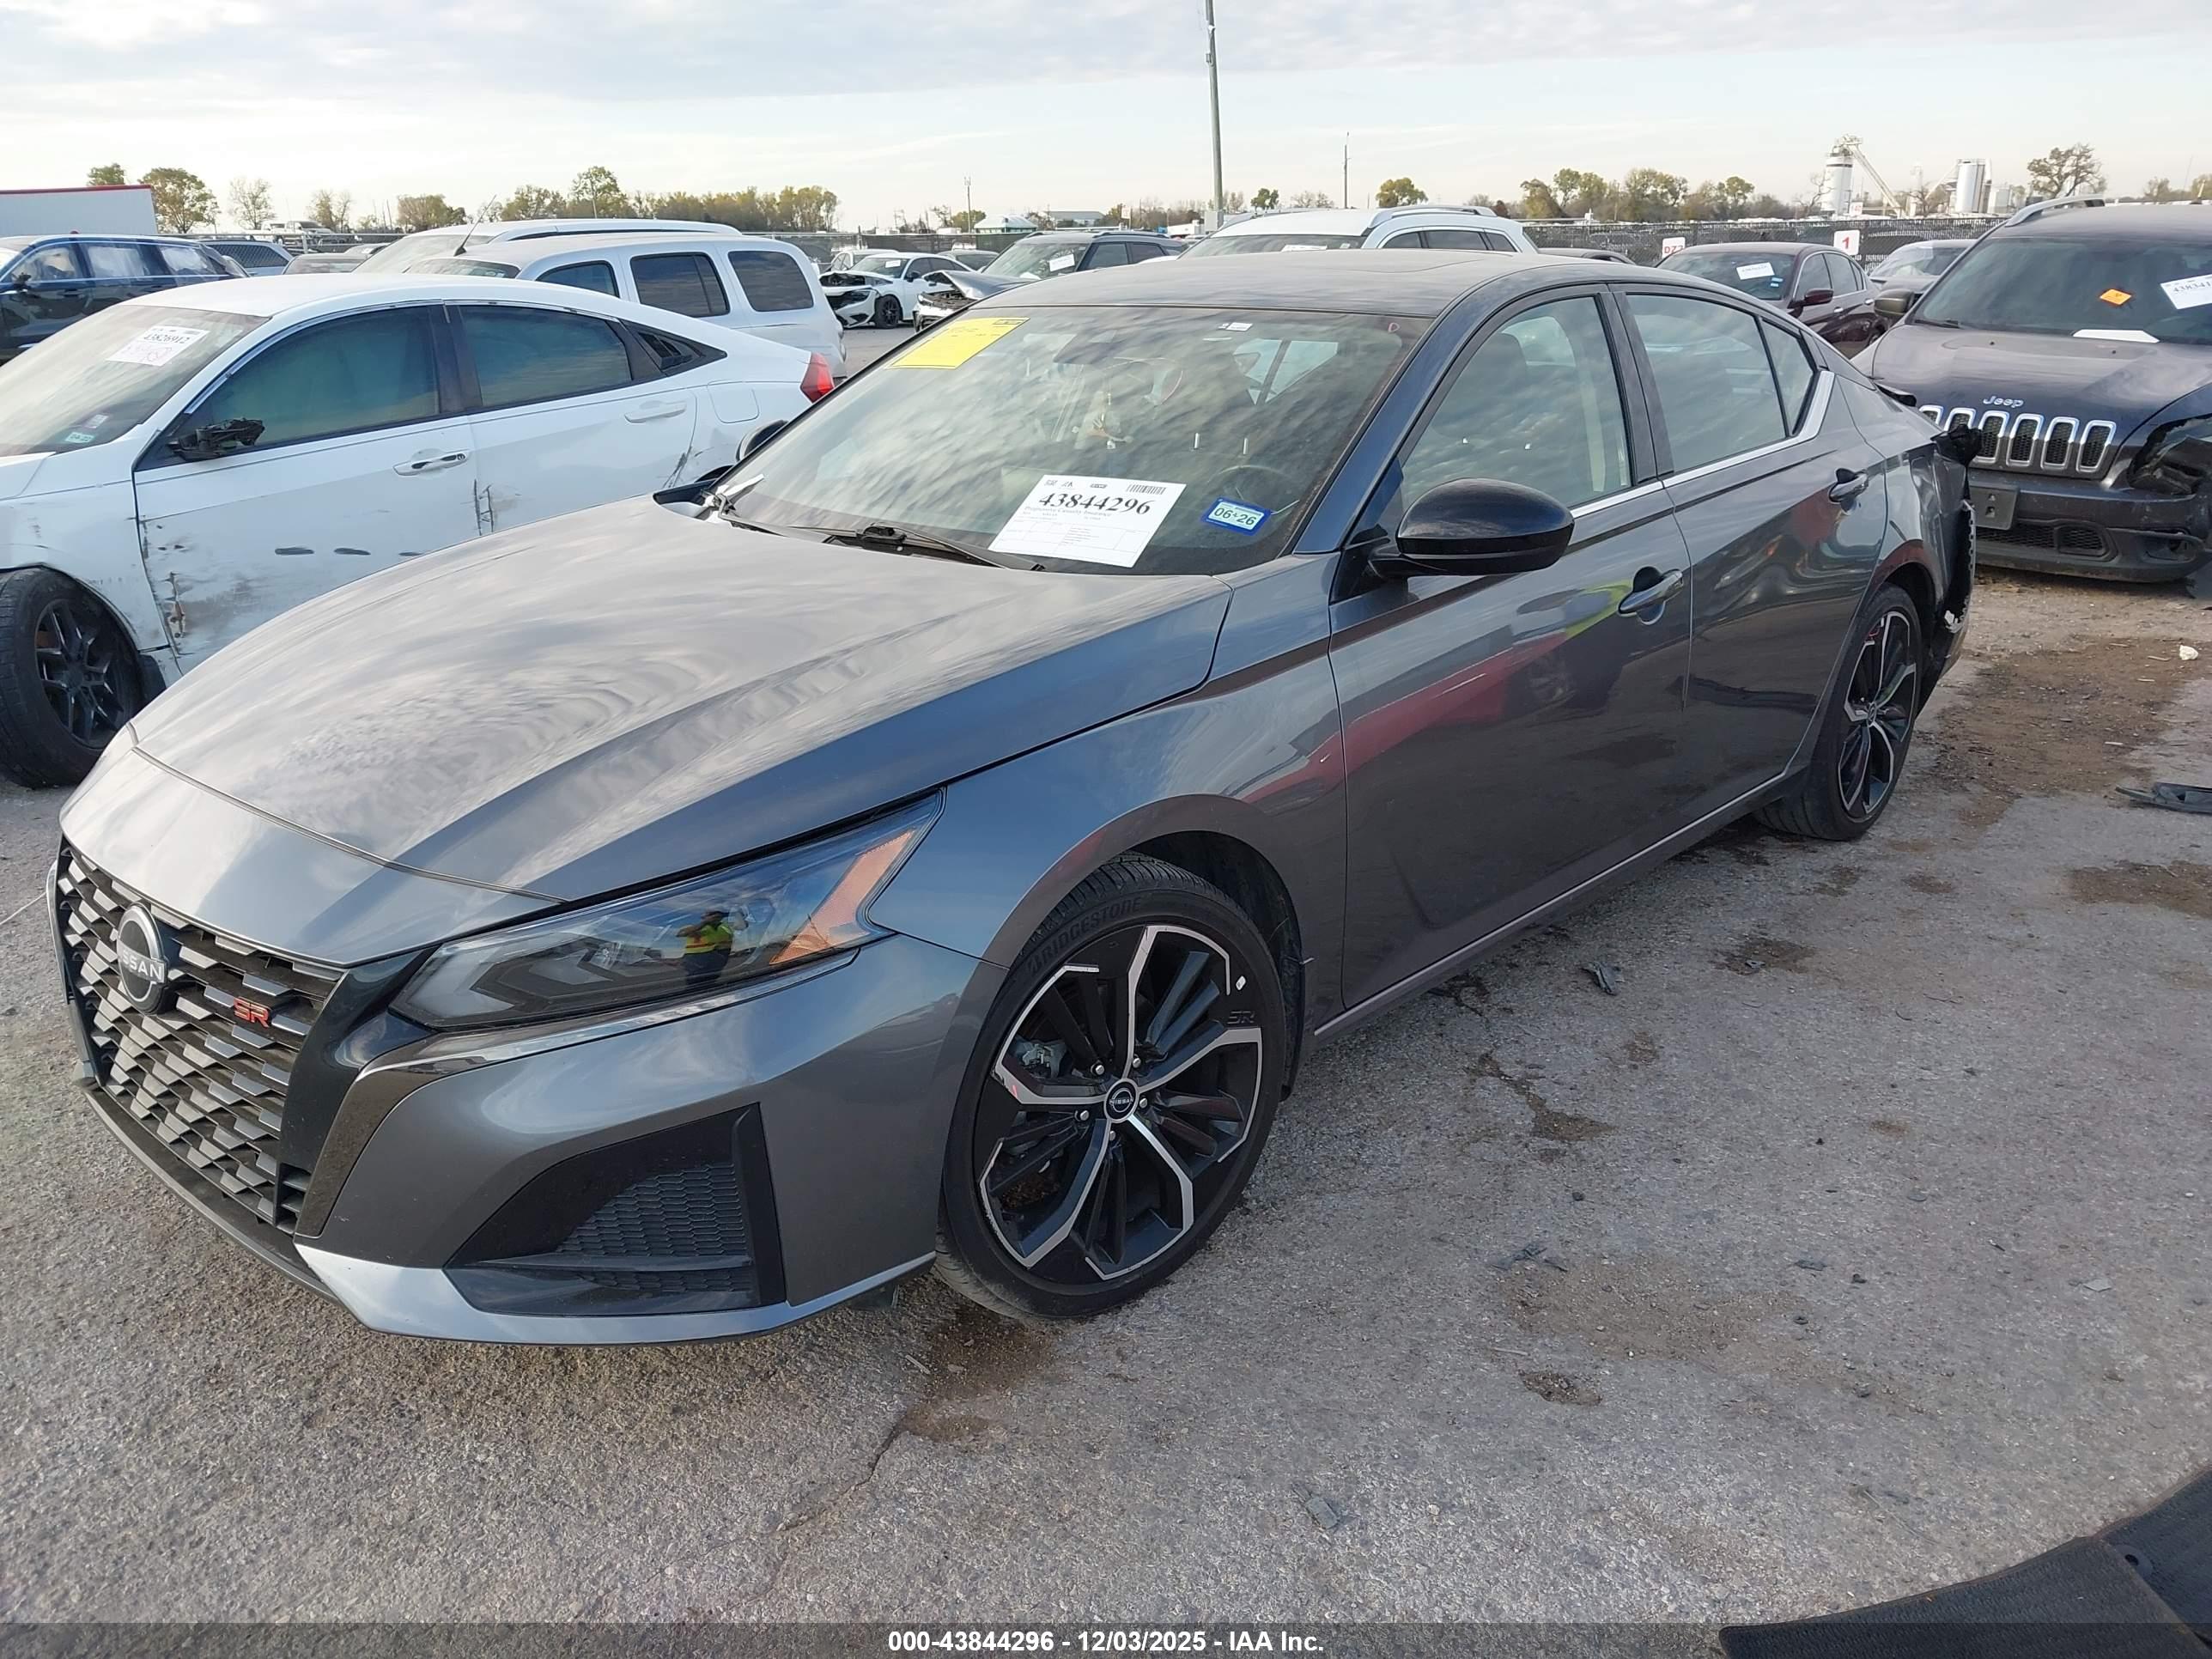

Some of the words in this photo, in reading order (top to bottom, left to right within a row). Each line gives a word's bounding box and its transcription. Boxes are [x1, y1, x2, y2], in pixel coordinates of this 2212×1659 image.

[1842, 236, 1850, 249] 1
[1983, 396, 2024, 408] Jeep
[1039, 493, 1156, 515] 43844296
[1028, 896, 1142, 974] BRIDGESTONE
[234, 996, 270, 1028] SR
[1227, 1011, 1255, 1024] SR
